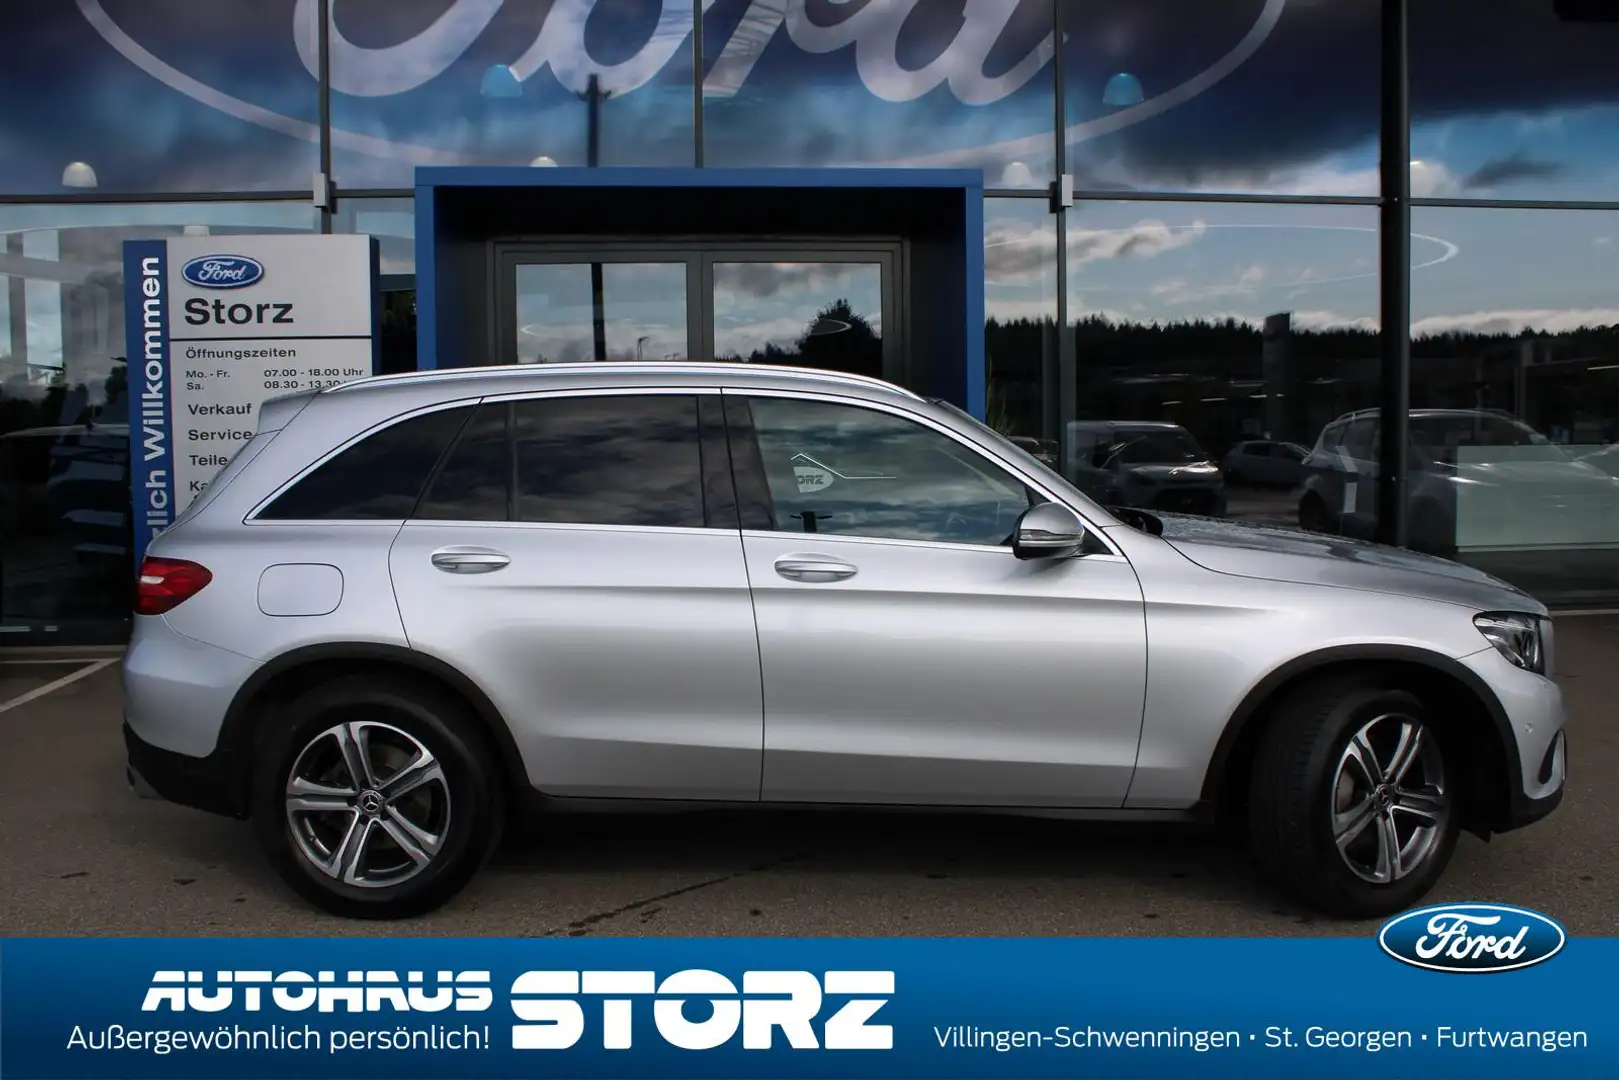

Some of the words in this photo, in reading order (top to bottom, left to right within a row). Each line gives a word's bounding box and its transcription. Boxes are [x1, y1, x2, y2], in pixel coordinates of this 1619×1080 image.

[198, 260, 246, 281] Ford
[184, 298, 294, 325] Storz
[142, 257, 165, 461] Willkommen
[186, 348, 296, 360] Öffnungszeiten
[186, 370, 207, 379] Mo.
[216, 370, 231, 378] Fr.
[264, 369, 297, 377] 07.00
[308, 368, 340, 377] 18.00
[343, 368, 363, 376] Uhr
[186, 382, 204, 391] Sa.
[264, 380, 298, 389] 08.30
[187, 403, 252, 415] Verkauf
[188, 429, 253, 440] Service
[189, 454, 228, 466] Teile
